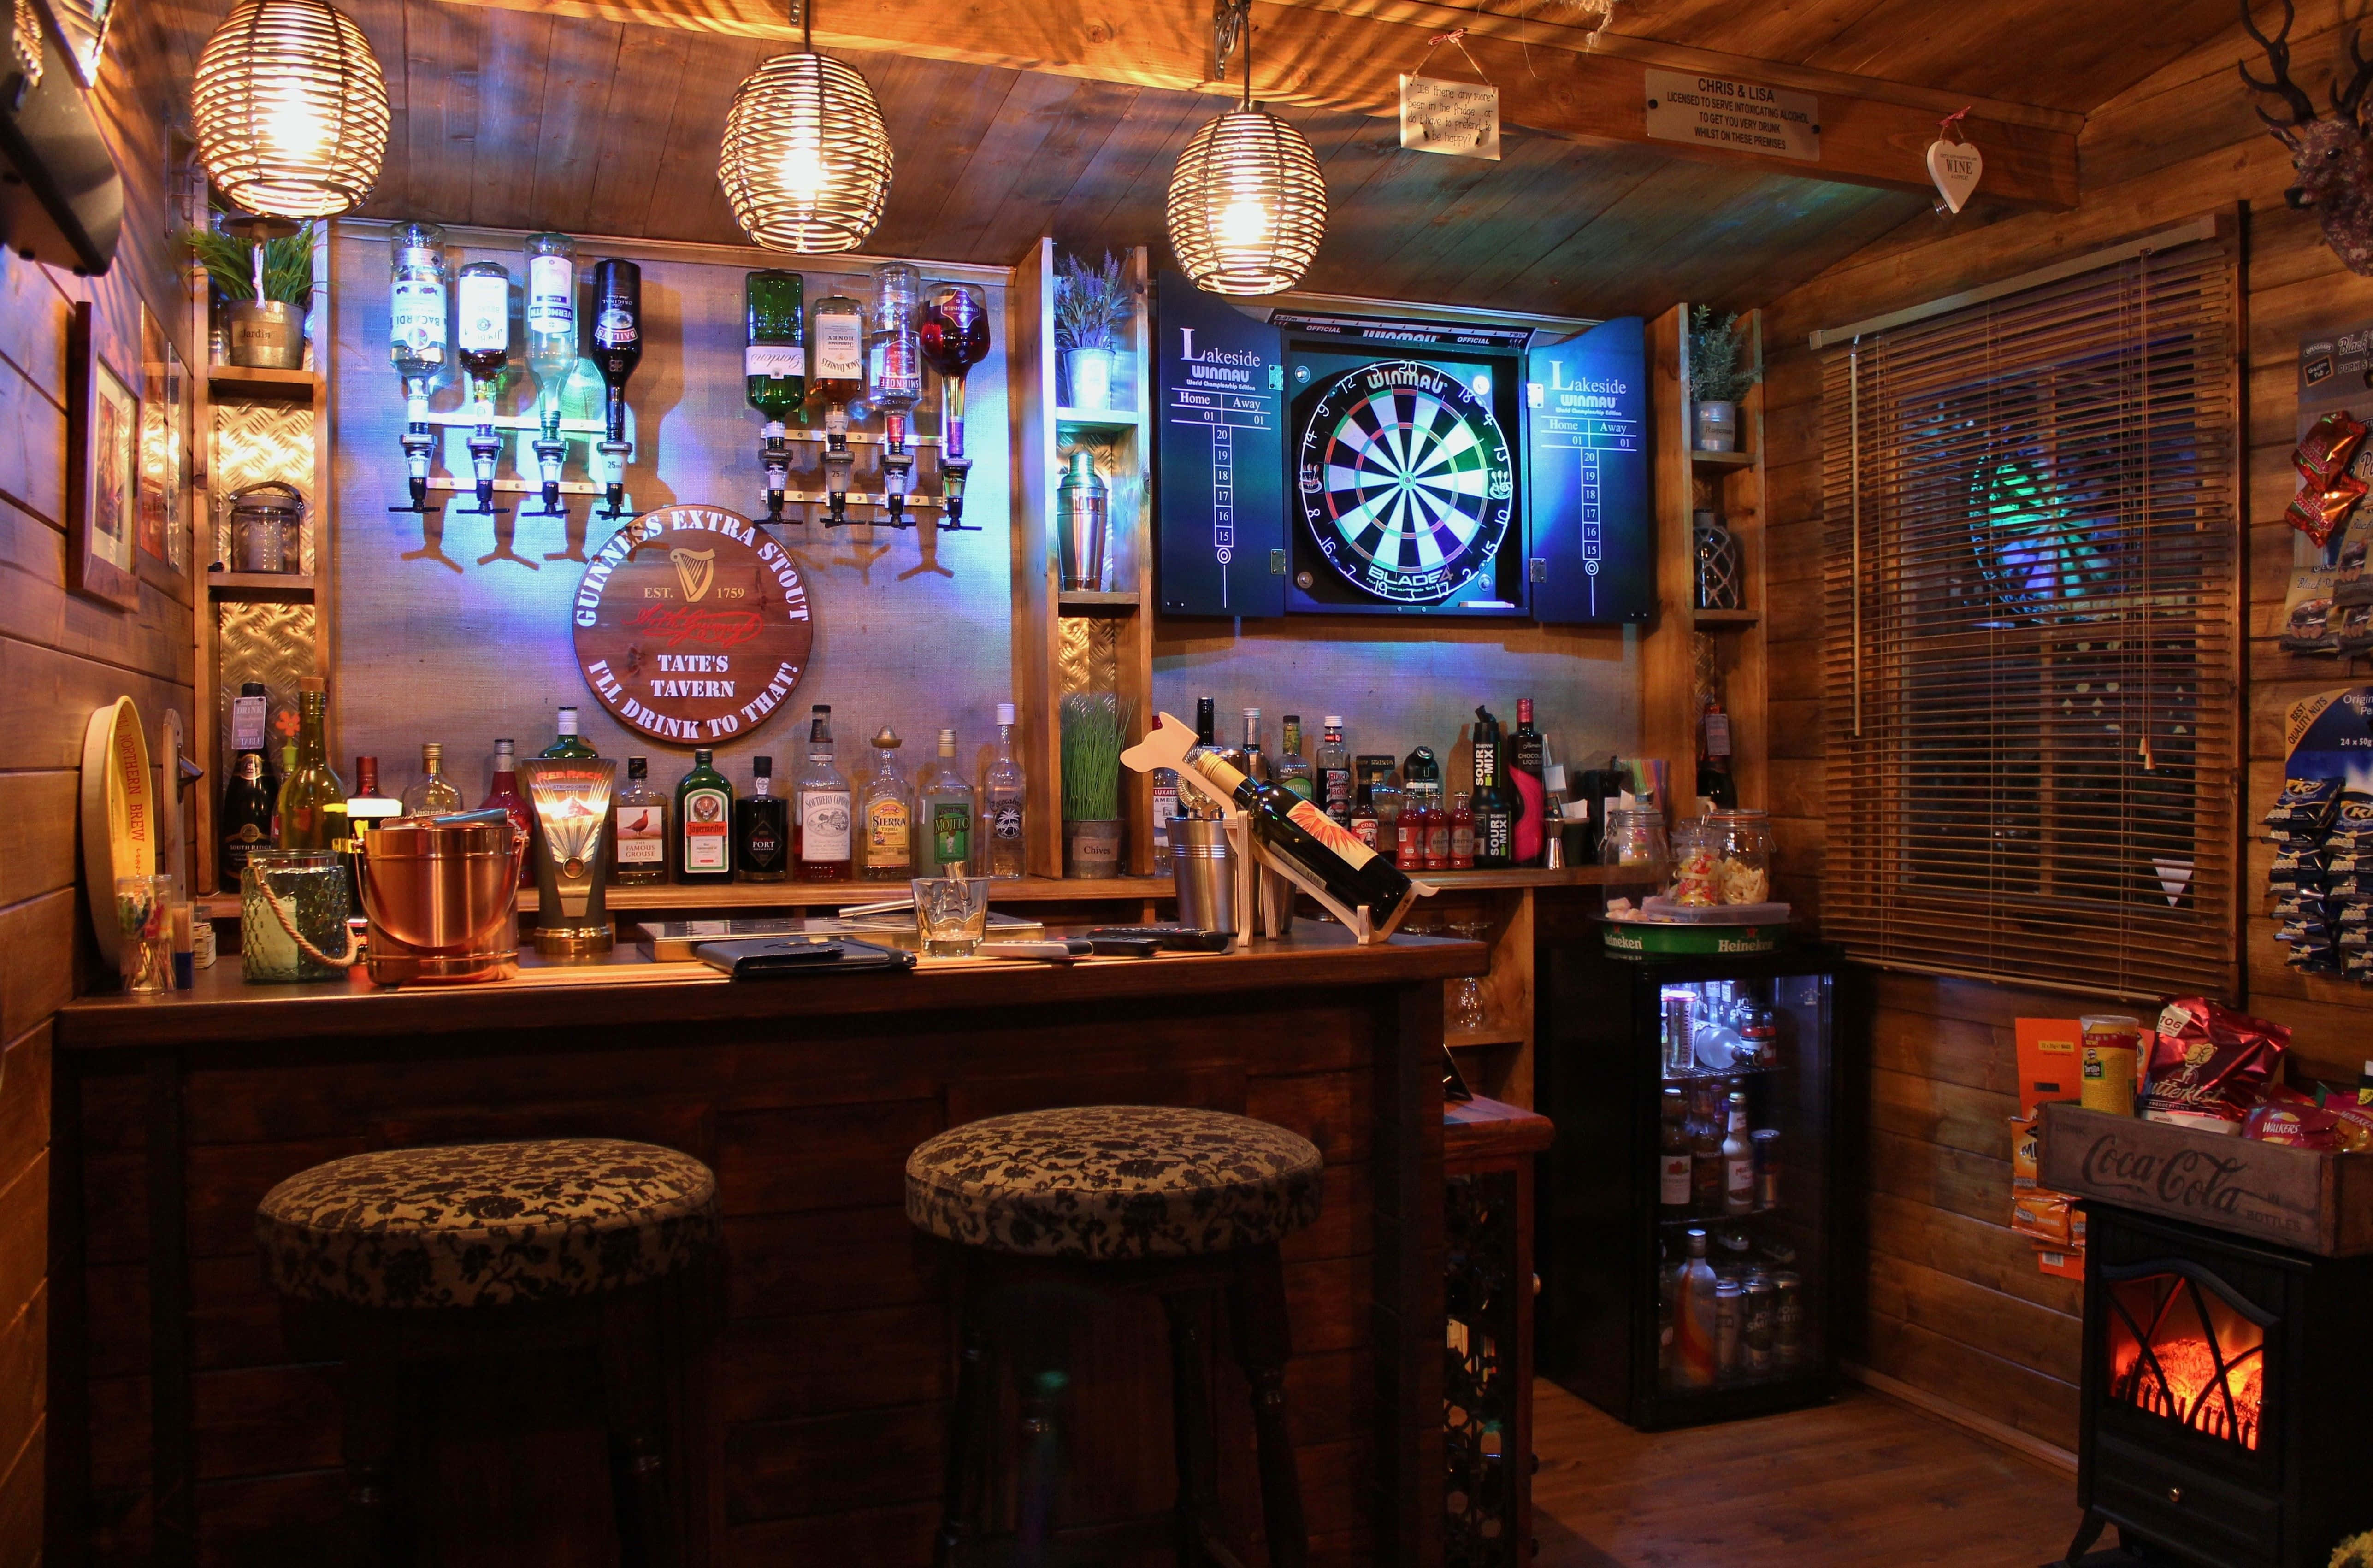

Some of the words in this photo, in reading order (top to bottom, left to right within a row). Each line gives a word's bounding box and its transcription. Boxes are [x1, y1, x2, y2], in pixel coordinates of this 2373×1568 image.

[1417, 84, 1429, 94] Is
[1434, 86, 1453, 98] there
[1458, 92, 1472, 103] any
[1474, 93, 1490, 101] more
[1698, 78, 1734, 96] CHRIS
[1738, 85, 1745, 97] &
[1749, 87, 1774, 103] LISA
[1408, 98, 1425, 109] beer
[1440, 103, 1450, 112] the
[1454, 103, 1475, 120] fridge
[1667, 92, 1700, 106] LICENSED
[1701, 97, 1711, 107] TO
[1712, 99, 1733, 111] SERVE
[1735, 103, 1778, 118] INTOXICATING
[1780, 111, 1809, 124] ALCOHOL
[1408, 111, 1416, 123] do
[1425, 114, 1441, 126] have
[1446, 117, 1452, 127] to
[1455, 118, 1481, 132] pretend
[1486, 121, 1491, 131] to
[1700, 112, 1708, 123] TO
[1710, 114, 1723, 124] GET
[1725, 116, 1739, 127] YOU
[1741, 118, 1757, 130] VERY
[1759, 121, 1780, 134] DRUNK
[1432, 130, 1441, 140] be
[1445, 132, 1471, 148] happy?
[1695, 126, 1719, 138] WHILST
[1721, 130, 1730, 141] ON
[1732, 132, 1753, 145] THESE
[1754, 135, 1785, 149] PREMISES
[1946, 159, 1972, 174] WINE
[242, 328, 271, 339] Jardin
[1457, 336, 1489, 345] OFFICIAL
[1180, 328, 1260, 368] Lakeside
[2338, 331, 2368, 356] Black
[750, 353, 803, 369] Gordon's
[844, 358, 860, 372] JACK
[1399, 361, 1417, 373] 20
[2338, 361, 2361, 374] PORK
[1192, 365, 1250, 383] WINMAU
[2308, 363, 2327, 374] Gastro
[880, 378, 918, 388] SMIRNOFF
[1338, 376, 1356, 393] 12
[1367, 370, 1445, 393] WINMAU
[1549, 360, 1626, 395] Lakeside
[1203, 380, 1238, 390] Championship
[1458, 385, 1473, 403] 18
[1561, 394, 1616, 408] WINMAU
[1180, 392, 1210, 405] Home
[1233, 397, 1260, 411] Away
[1318, 404, 1329, 417] 9
[1204, 411, 1214, 421] 01
[1254, 415, 1264, 426] 01
[1483, 413, 1494, 426] 4
[1550, 419, 1578, 430] Home
[1600, 422, 1627, 434] Away
[1216, 430, 1227, 440] 20
[1303, 430, 1318, 448] 14
[1572, 436, 1582, 445] 01
[1620, 438, 1629, 448] 01
[1217, 450, 1228, 460] 19
[1493, 445, 1508, 461] 13
[1584, 453, 1595, 462] 20
[1217, 470, 1228, 480] 18
[1585, 471, 1595, 481] 19
[1218, 491, 1228, 501] 17
[1586, 490, 1595, 499] 18
[1219, 511, 1228, 521] 16
[1306, 508, 1321, 517] 8
[1494, 509, 1510, 525] 10
[1586, 509, 1595, 518] 17
[1219, 531, 1229, 542] 15
[1587, 527, 1596, 536] 16
[1320, 538, 1336, 557] 16
[1482, 540, 1498, 557] 15
[1587, 546, 1596, 554] 15
[577, 515, 663, 627] GUINNESS
[670, 510, 756, 547] EXTRA
[757, 542, 809, 622] STOUT
[1462, 568, 1474, 581] 2
[2297, 577, 2320, 589] Black
[644, 588, 673, 598] EST.
[717, 588, 744, 598] 1759
[657, 655, 728, 672] TATE'S
[651, 680, 735, 697] TAVERN
[588, 660, 623, 704] I'LL
[620, 697, 700, 739] DRINK
[707, 716, 738, 737] TO
[741, 662, 798, 723] THAT!
[2343, 694, 2373, 706] Origin
[237, 706, 262, 714] DRINK
[2290, 702, 2306, 722] BEST
[2288, 713, 2311, 744] QUALITY
[2308, 696, 2327, 716] NUTS
[2359, 738, 2371, 747] 50g
[119, 733, 142, 795] NORTHERN
[1476, 749, 1484, 786] SOUR
[1484, 749, 1493, 774] MIX
[536, 771, 565, 781] RED
[567, 771, 602, 780] ROCK
[805, 796, 832, 808] SOUTHERN
[130, 803, 145, 842] BREW
[873, 816, 906, 827] SIERRA
[935, 818, 969, 834] MOJITO
[1490, 820, 1499, 856] SOUR
[1083, 845, 1111, 855] Chives
[1718, 940, 1773, 952] Heineken
[2160, 1016, 2183, 1029] 106
[2262, 1122, 2301, 1133] WALKERS
[2245, 1209, 2301, 1232] BOTTLES
